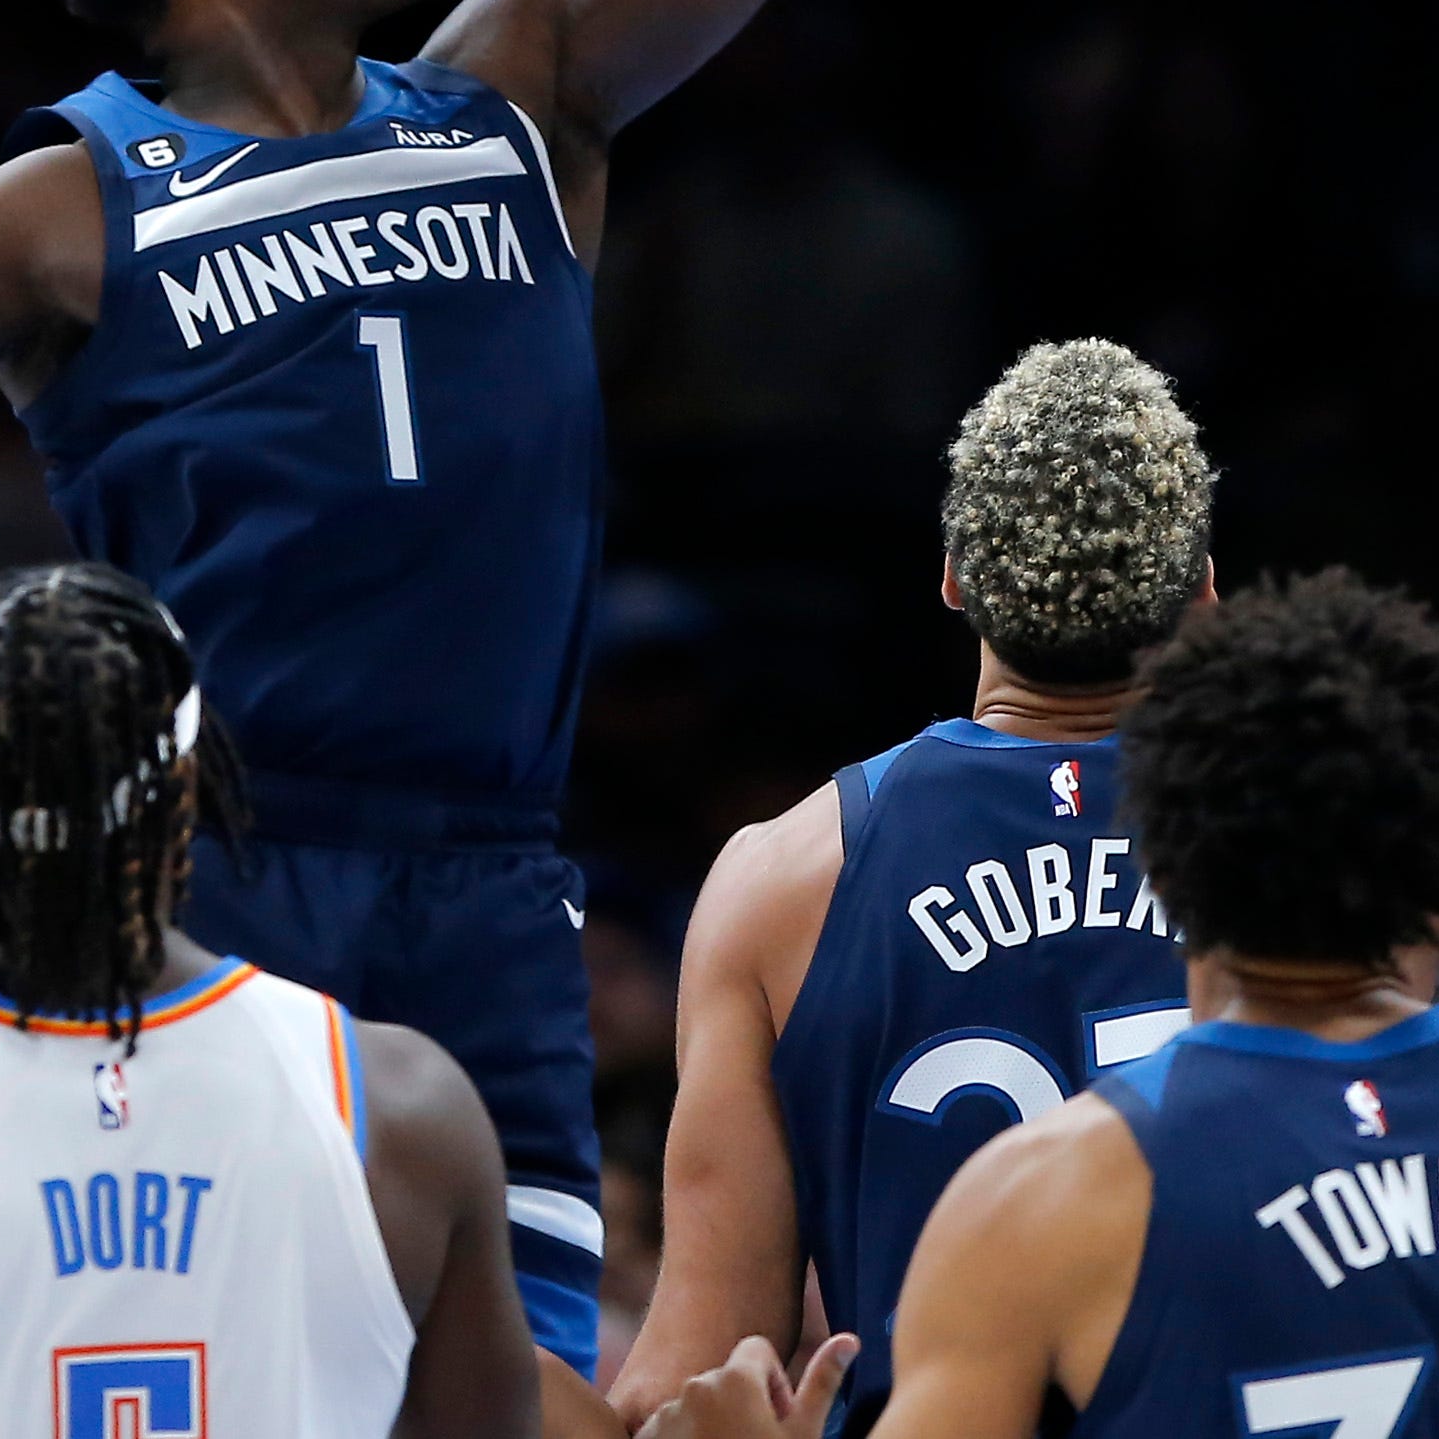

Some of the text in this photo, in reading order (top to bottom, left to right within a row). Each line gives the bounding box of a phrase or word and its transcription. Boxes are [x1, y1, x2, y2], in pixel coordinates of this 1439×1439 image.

[137, 139, 176, 167] 6
[159, 203, 534, 350] MINNESOTA
[358, 316, 419, 481] 1
[908, 837, 1186, 972] GOBE
[41, 1172, 212, 1276] DORT
